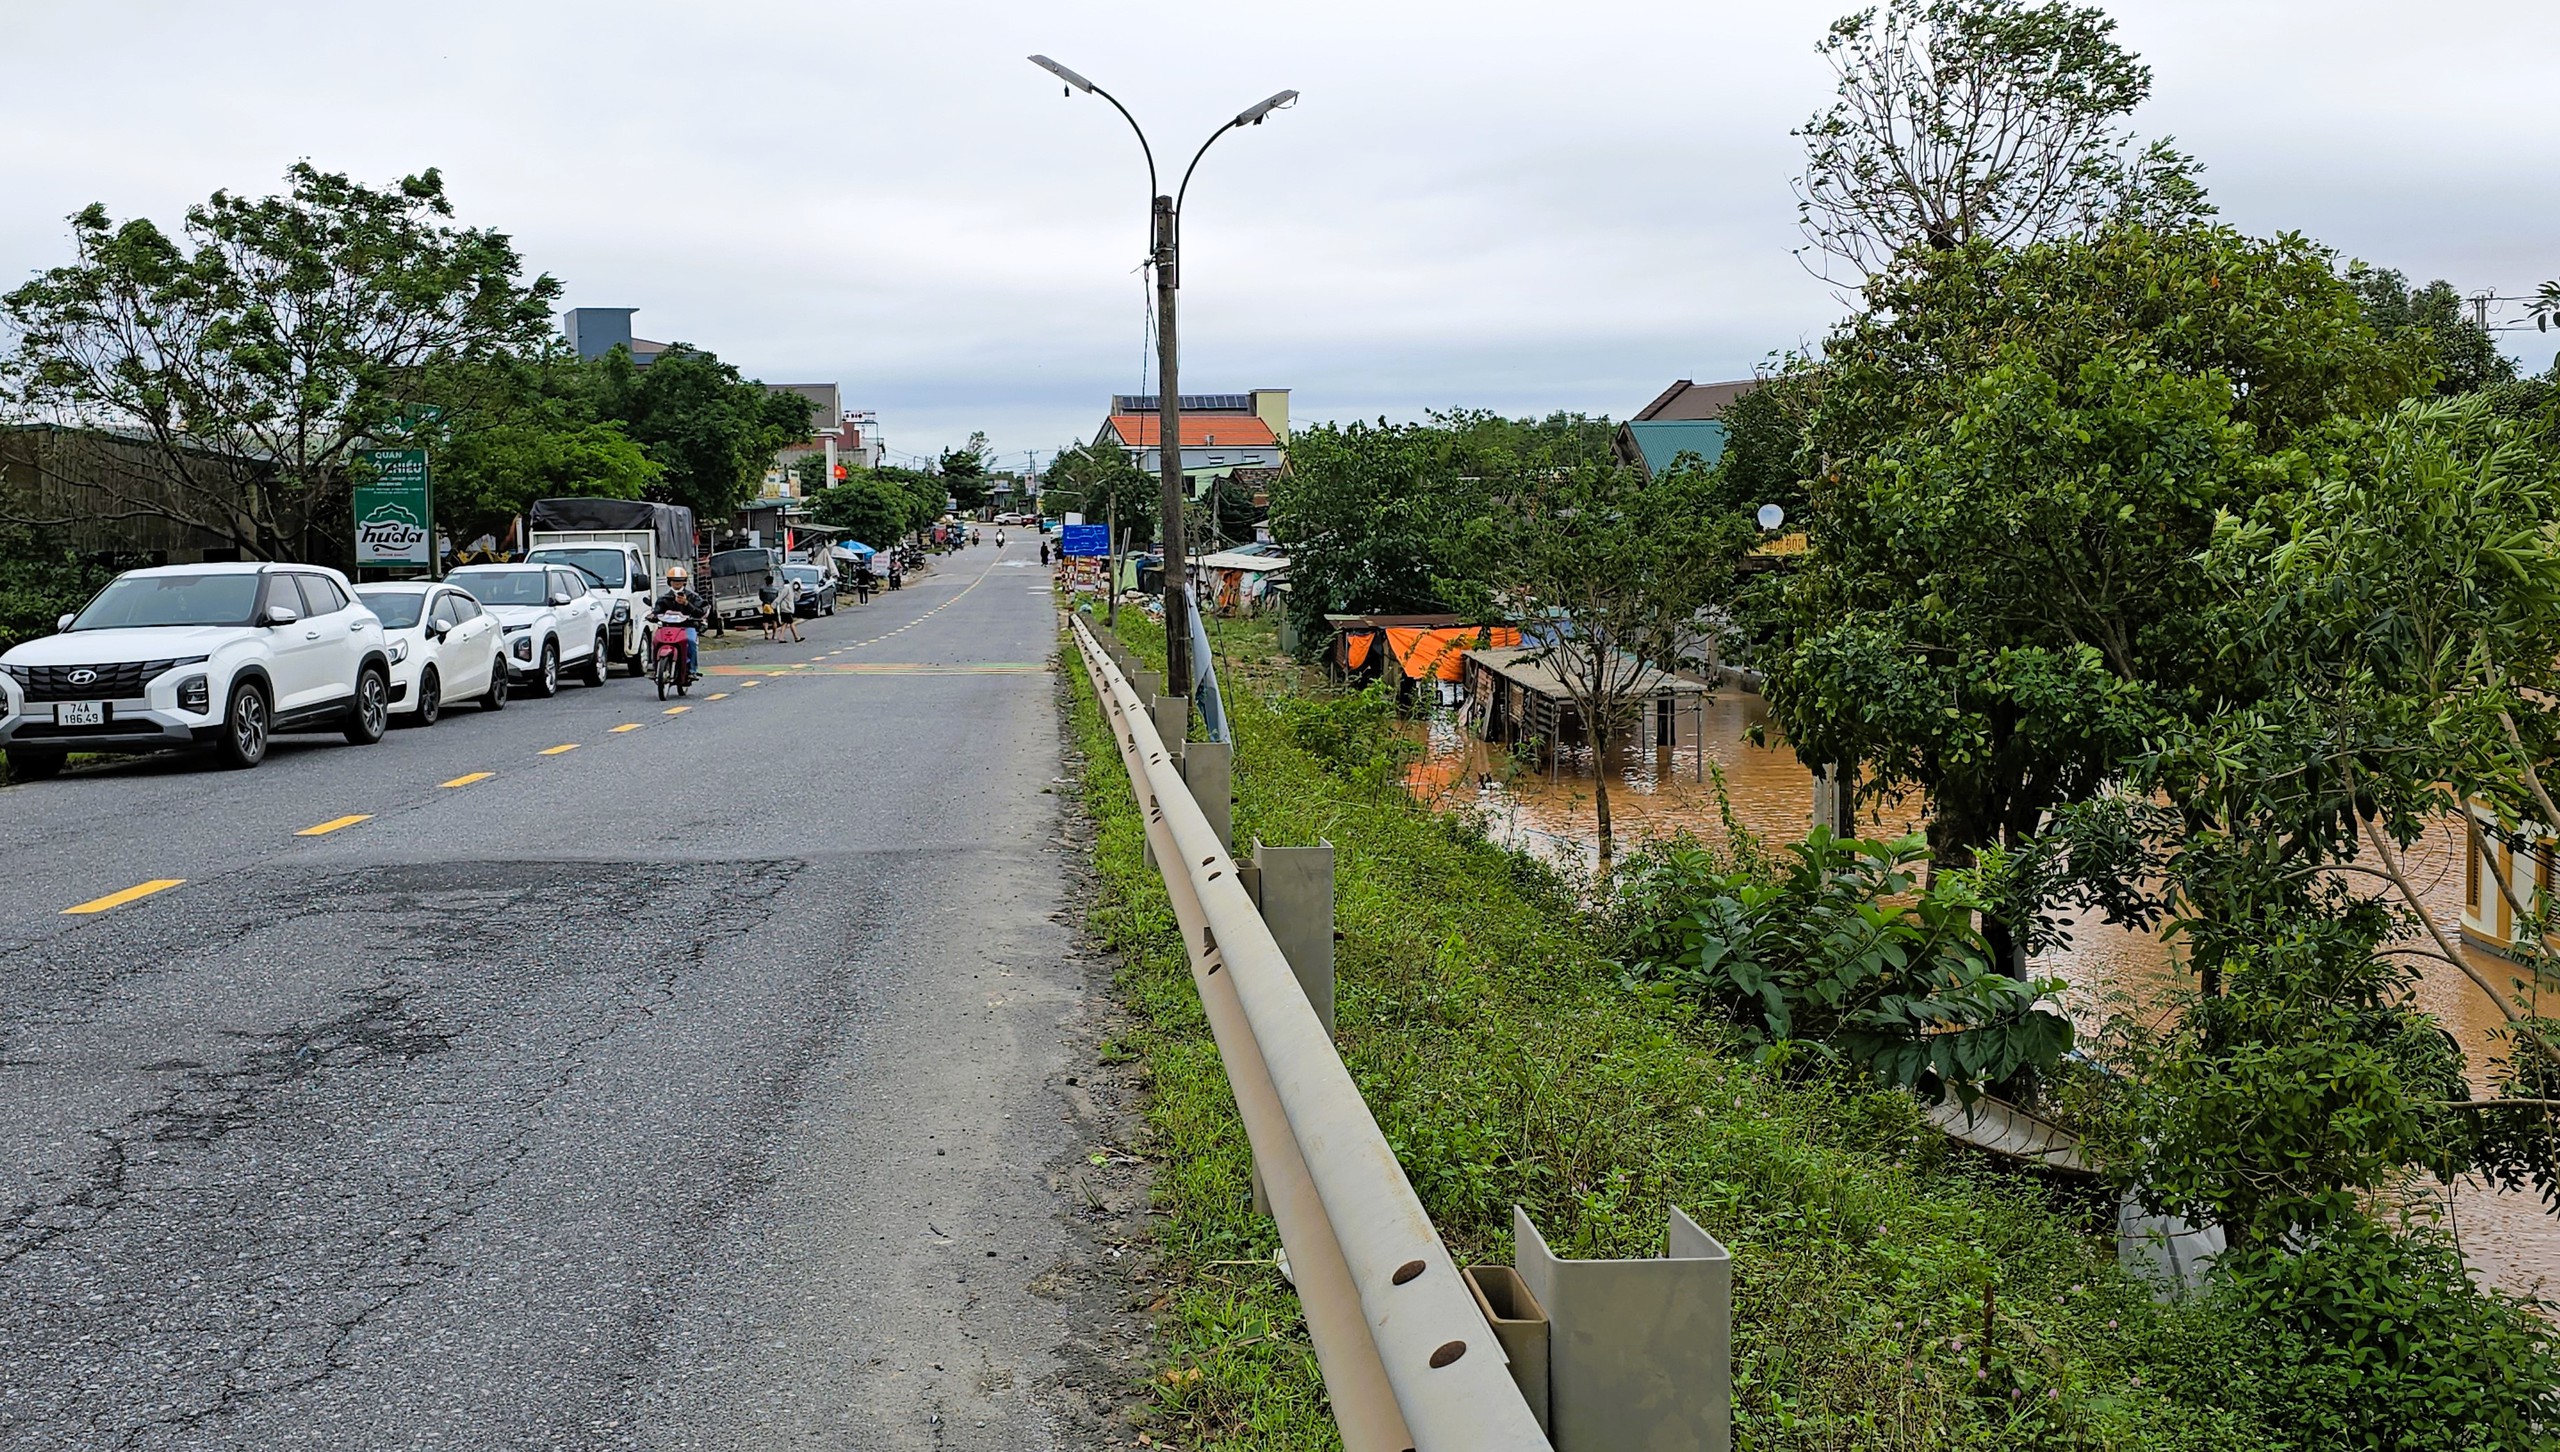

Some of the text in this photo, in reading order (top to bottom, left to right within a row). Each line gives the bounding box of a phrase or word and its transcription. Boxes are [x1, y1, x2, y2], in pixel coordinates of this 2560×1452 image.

[361, 523, 424, 543] huda
[70, 702, 90, 713] 74A
[65, 713, 98, 724] 186.49
